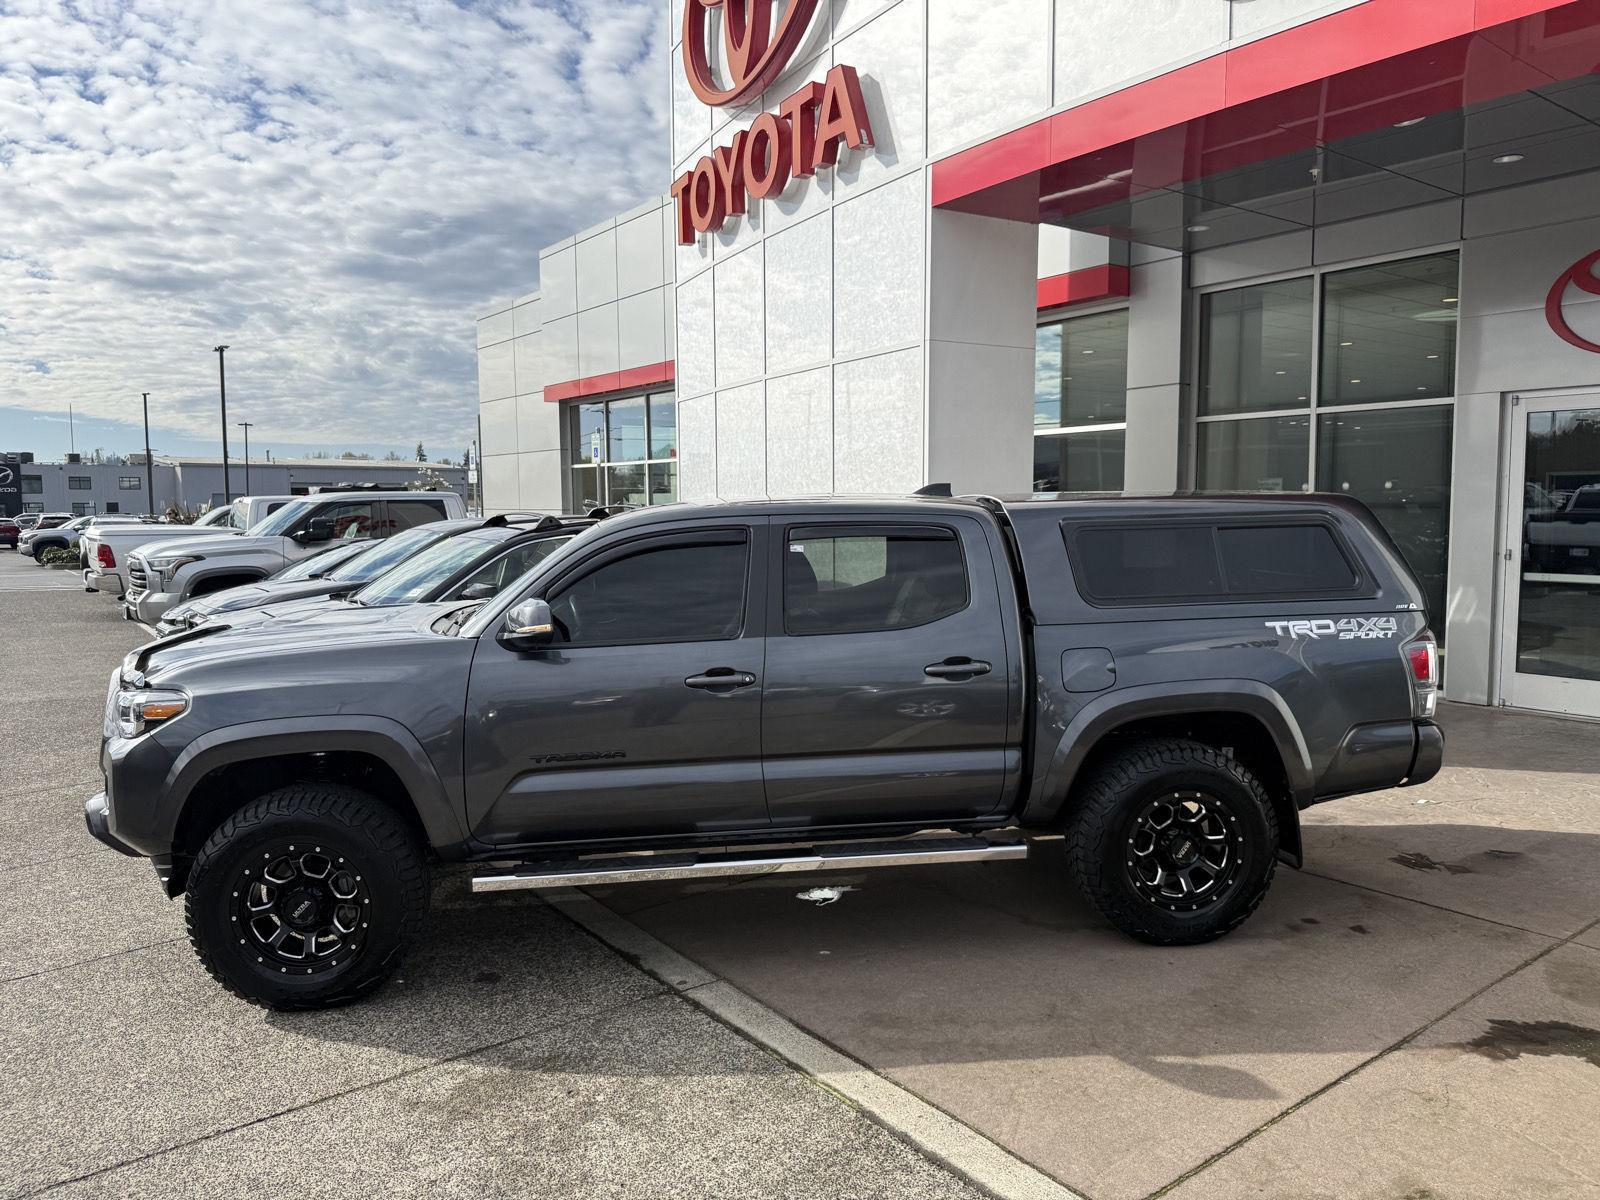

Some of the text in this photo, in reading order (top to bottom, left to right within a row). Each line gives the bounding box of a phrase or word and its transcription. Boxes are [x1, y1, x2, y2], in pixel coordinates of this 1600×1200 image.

[671, 63, 875, 246] TOYOTA
[1265, 619, 1337, 640] TRD
[1338, 630, 1396, 640] SPORT
[528, 750, 627, 763] TACOMA
[291, 900, 312, 919] ULTRA
